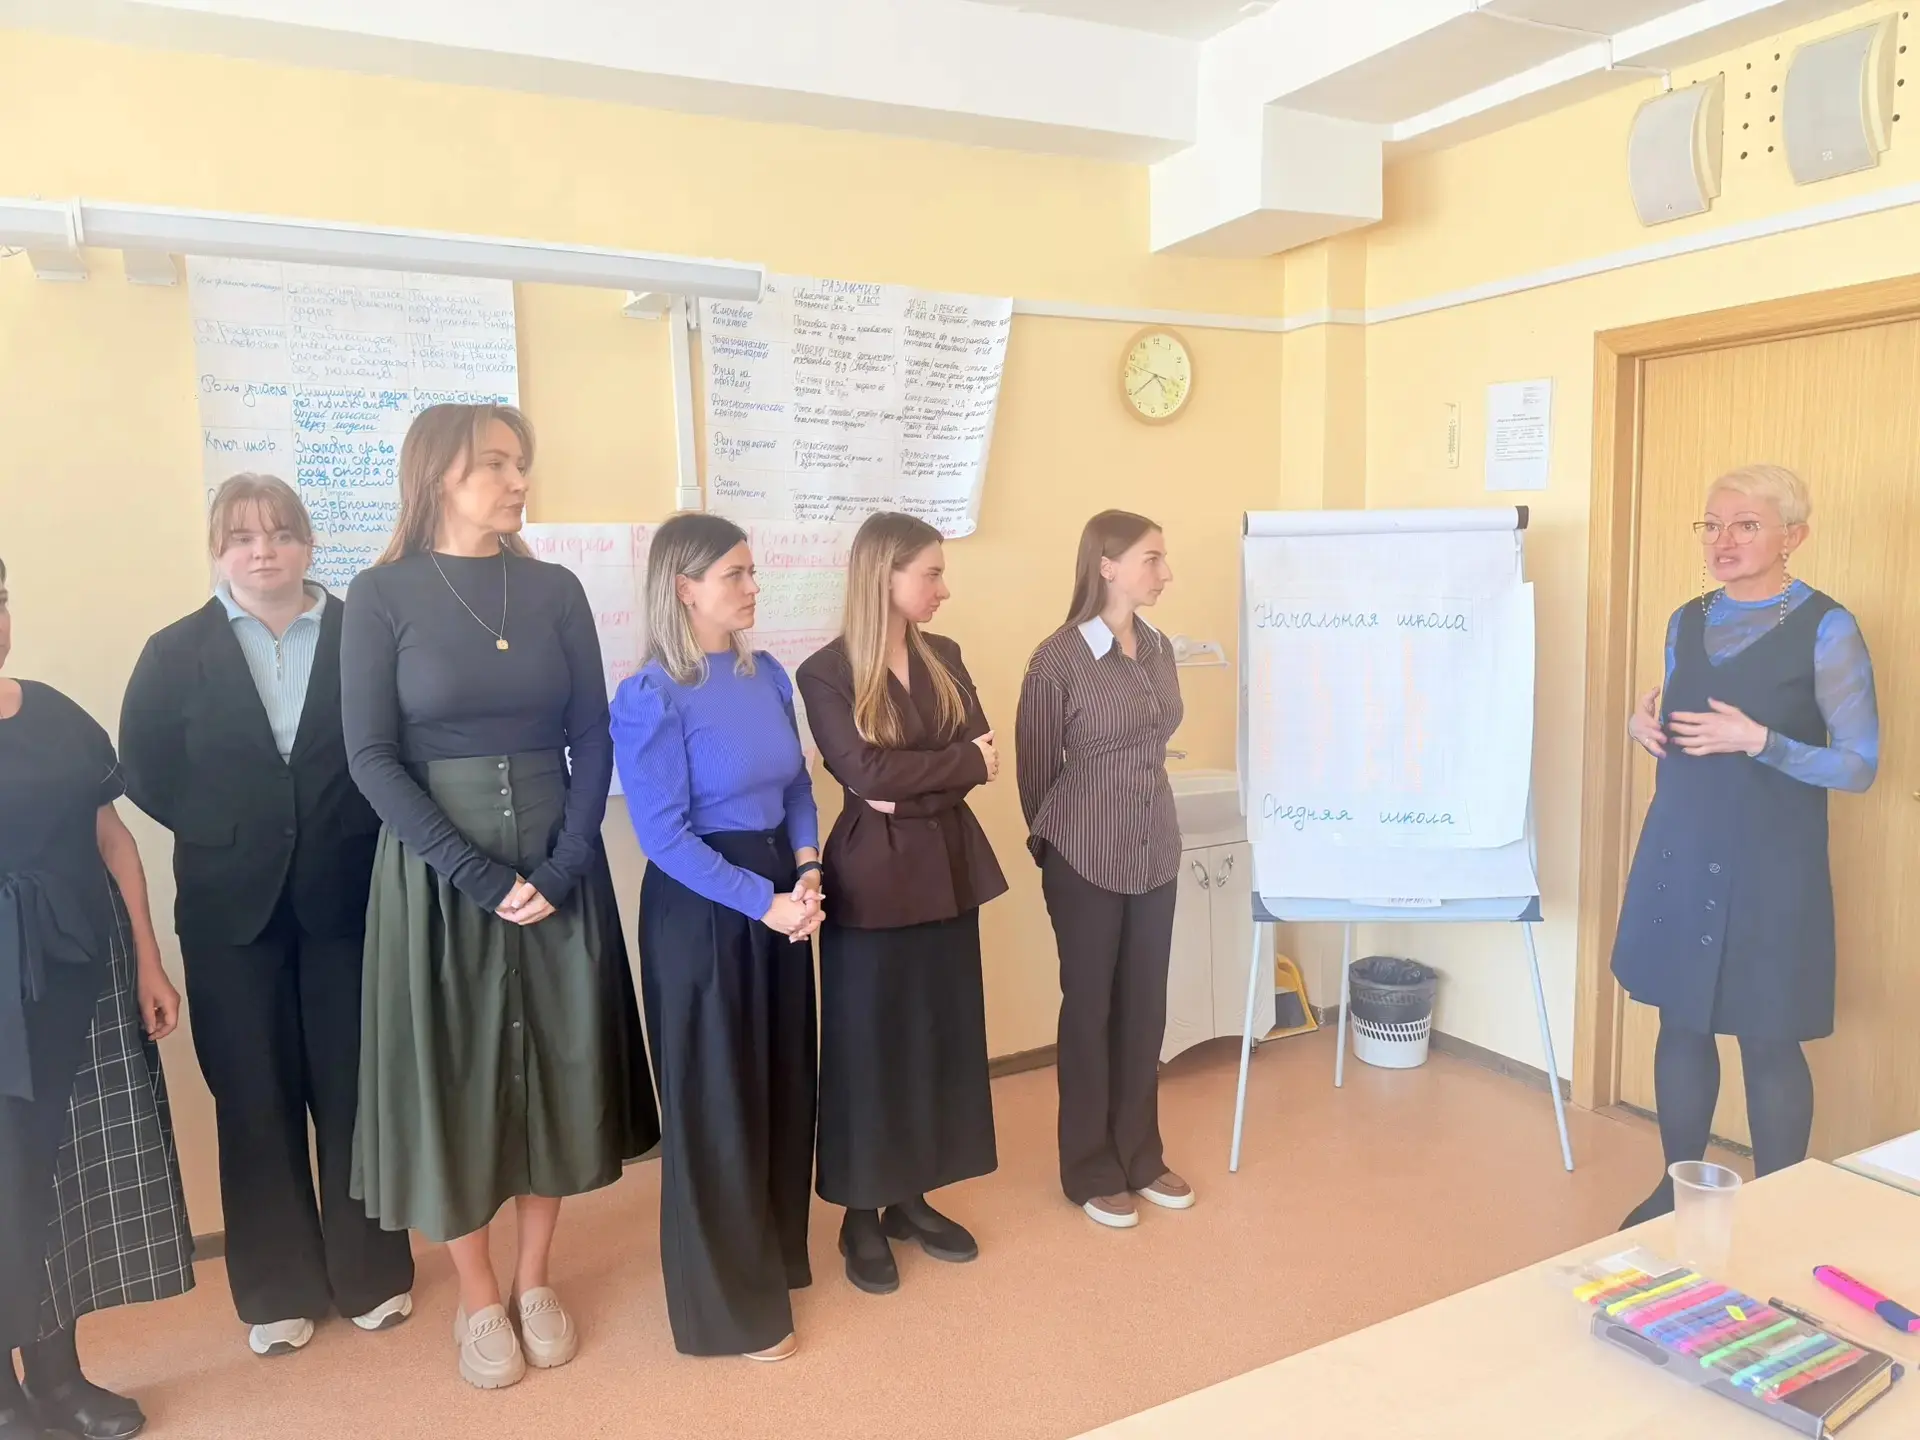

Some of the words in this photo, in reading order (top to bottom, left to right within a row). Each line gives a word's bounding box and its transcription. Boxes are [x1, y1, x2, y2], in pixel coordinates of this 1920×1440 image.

[822, 279, 881, 296] РАЗЛИЧИЯ
[857, 295, 880, 306] КЛАСС
[201, 375, 240, 393] Роль
[243, 384, 288, 408] учителя
[333, 466, 380, 481] опора
[1254, 600, 1379, 629] Начальная
[1396, 612, 1468, 632] школа
[1262, 792, 1354, 831] Средняя
[1379, 809, 1456, 825] школа
